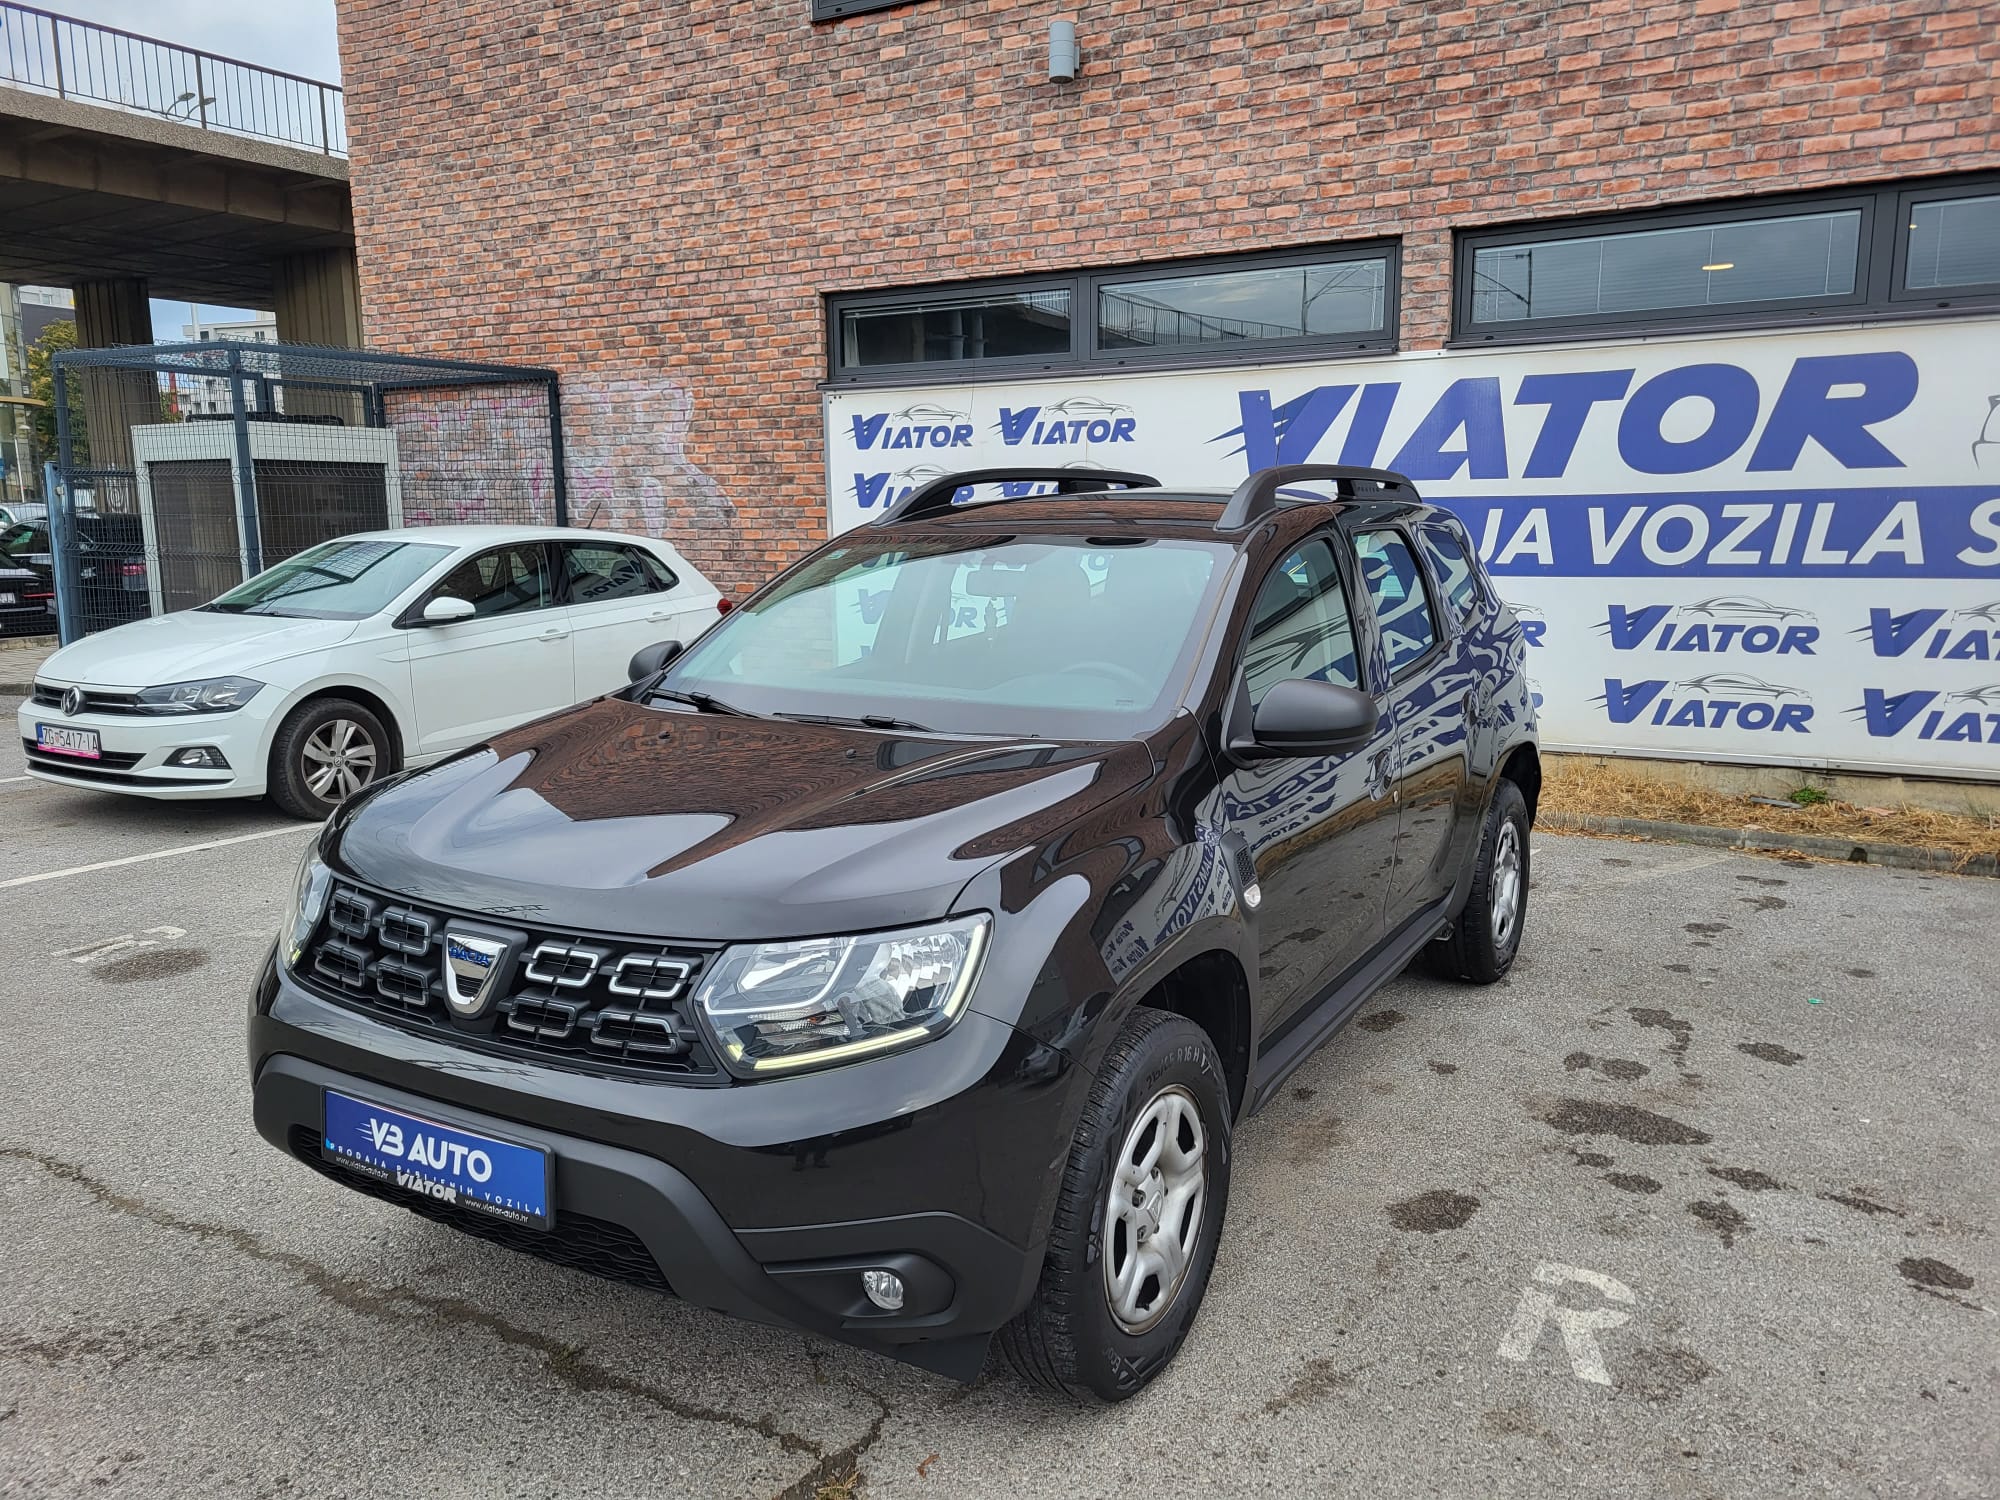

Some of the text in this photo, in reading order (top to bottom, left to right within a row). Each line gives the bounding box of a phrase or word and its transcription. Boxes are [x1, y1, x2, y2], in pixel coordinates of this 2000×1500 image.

[845, 414, 973, 450] VIATOR
[992, 406, 1136, 446] VIATOR
[1236, 351, 1919, 481] VIATOR
[1588, 501, 1924, 565] VOZILA
[1594, 604, 1819, 656] VIATOR
[1850, 608, 2000, 661] VIA
[1592, 678, 1814, 734] VIATOR
[407, 1133, 493, 1183] AUTO
[396, 1171, 457, 1204] VIATOR
[464, 1198, 529, 1224] www.viator-auto.hr
[484, 1191, 541, 1216] VOZILA
[1498, 1262, 1636, 1387] R
